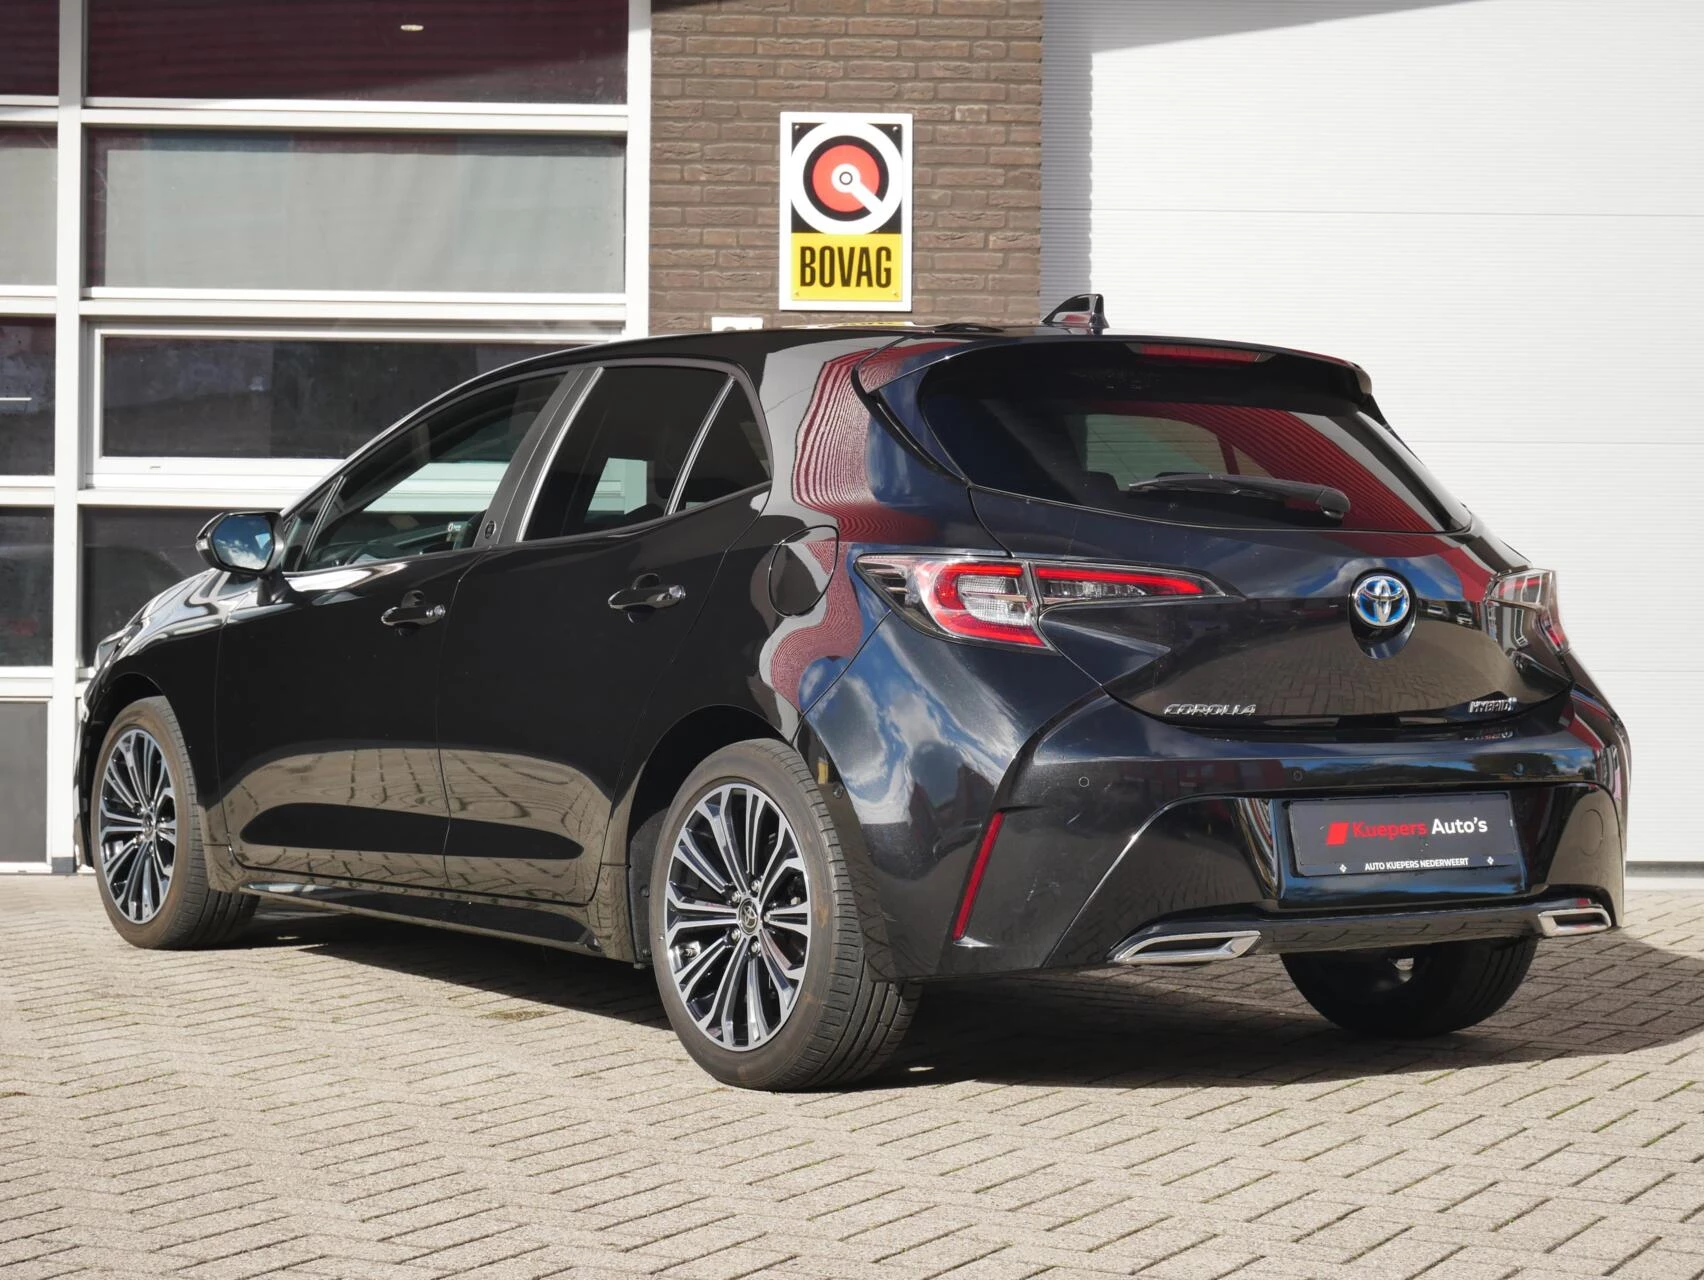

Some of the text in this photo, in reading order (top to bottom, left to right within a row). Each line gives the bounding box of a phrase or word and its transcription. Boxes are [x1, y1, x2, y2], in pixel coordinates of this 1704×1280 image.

[800, 245, 892, 288] BOVAG
[1352, 816, 1489, 840] Kuepers Auto's
[1364, 857, 1469, 871] AUTO KUEPERS NEDERWEERT
